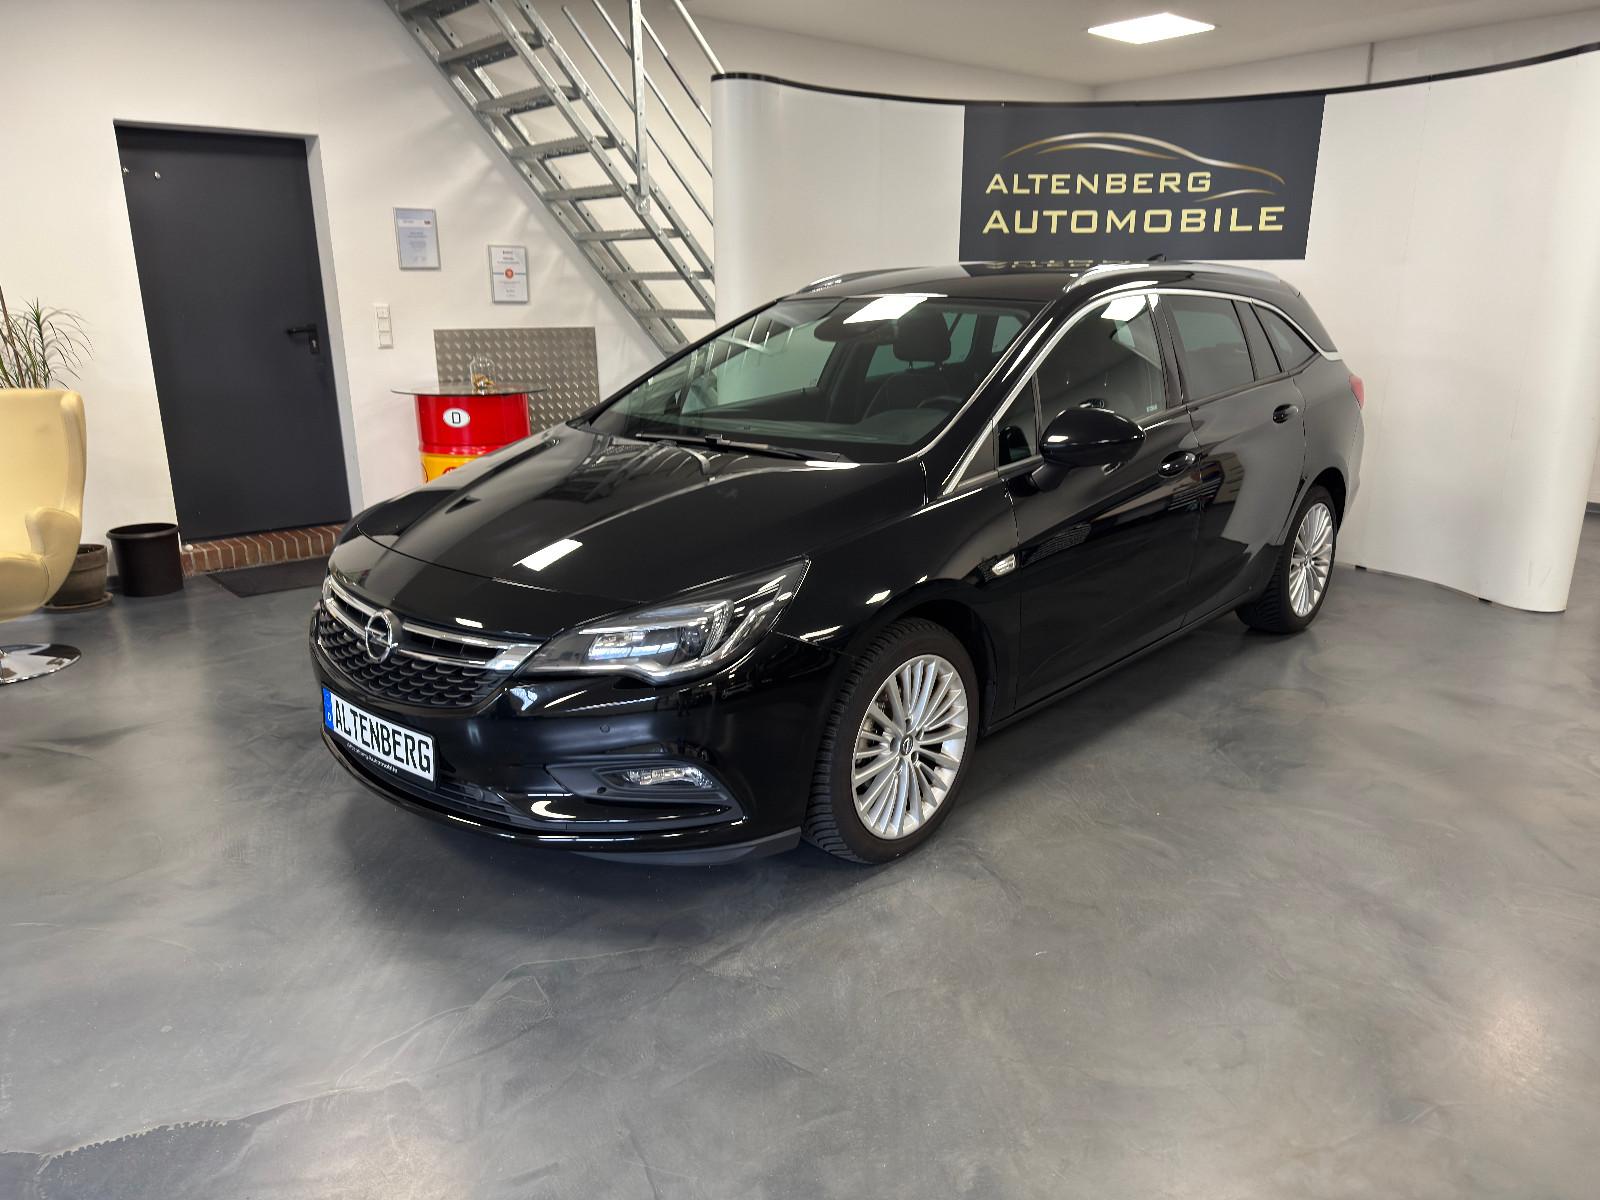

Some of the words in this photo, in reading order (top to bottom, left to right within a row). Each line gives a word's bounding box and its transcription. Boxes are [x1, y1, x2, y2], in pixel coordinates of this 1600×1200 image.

[985, 171, 1212, 195] ALTENBERG
[982, 206, 1286, 234] AUTOMOBILE
[451, 411, 461, 424] D
[335, 699, 432, 774] ALTENBERG
